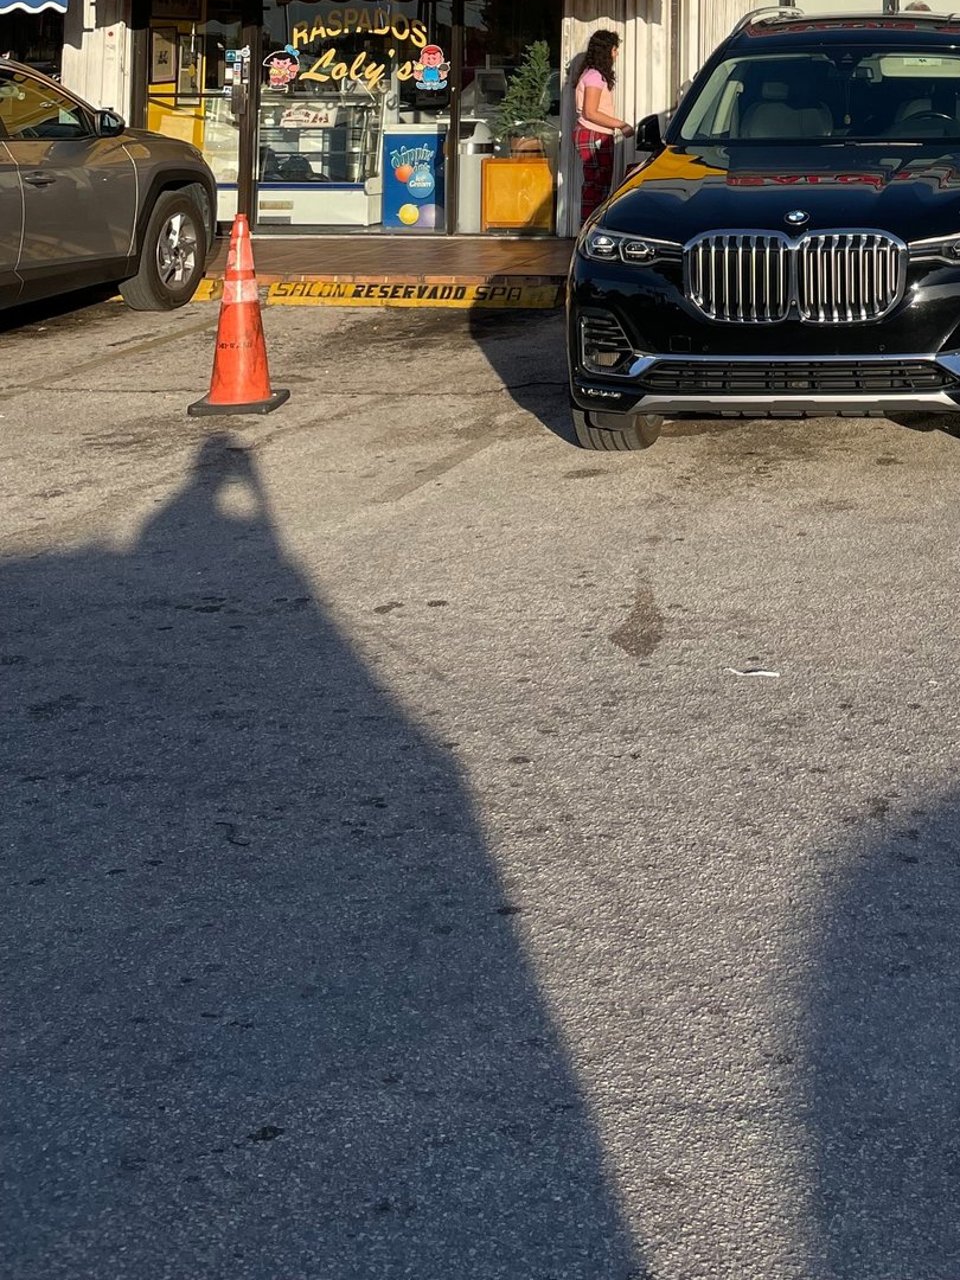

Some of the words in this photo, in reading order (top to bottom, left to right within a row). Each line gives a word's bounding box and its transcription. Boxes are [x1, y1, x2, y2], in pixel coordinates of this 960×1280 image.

[293, 7, 428, 48] RASPADOS
[299, 48, 414, 89] Loly's
[273, 282, 346, 297] SALON
[352, 284, 467, 300] RESERVADO
[473, 286, 522, 301] SPA
